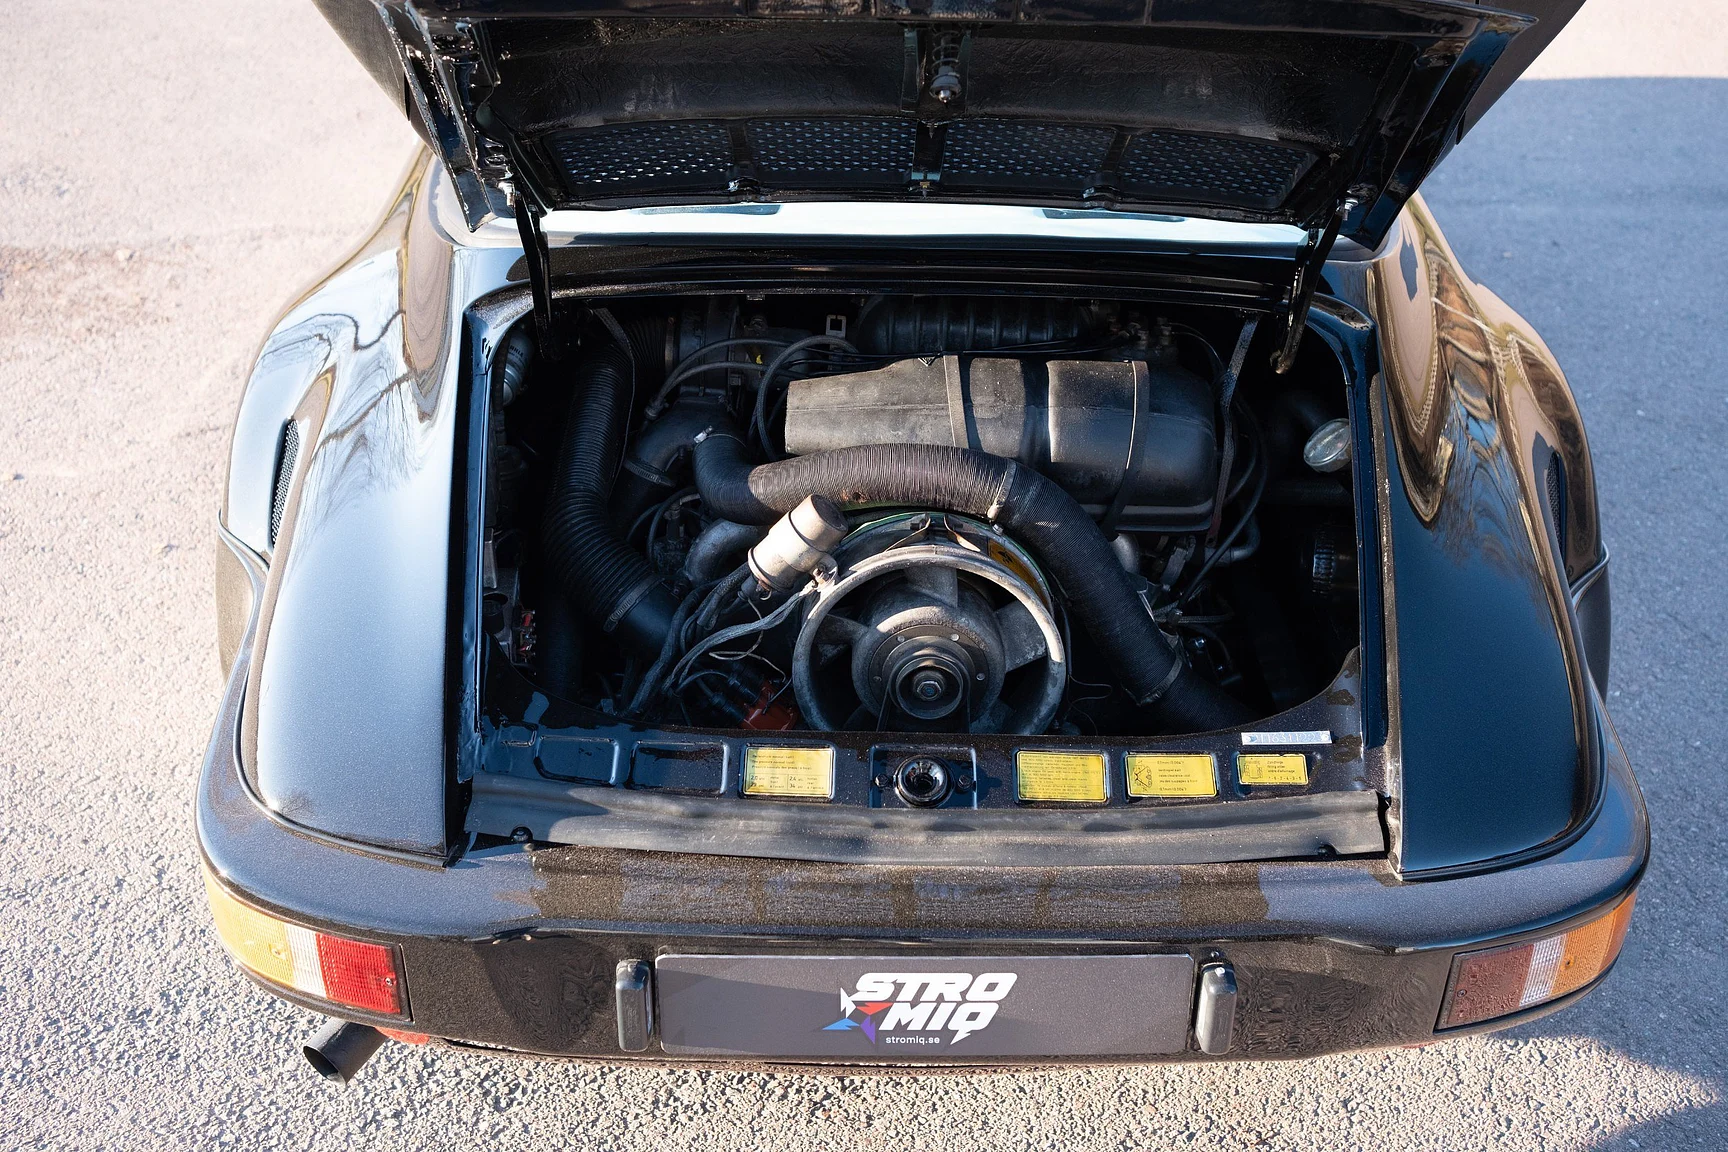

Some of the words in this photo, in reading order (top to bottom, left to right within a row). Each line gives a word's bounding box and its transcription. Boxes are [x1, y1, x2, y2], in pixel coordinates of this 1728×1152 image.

[849, 972, 1018, 1002] STRO
[878, 1002, 1000, 1045] MIQ
[885, 1035, 941, 1046] stromiq.se
